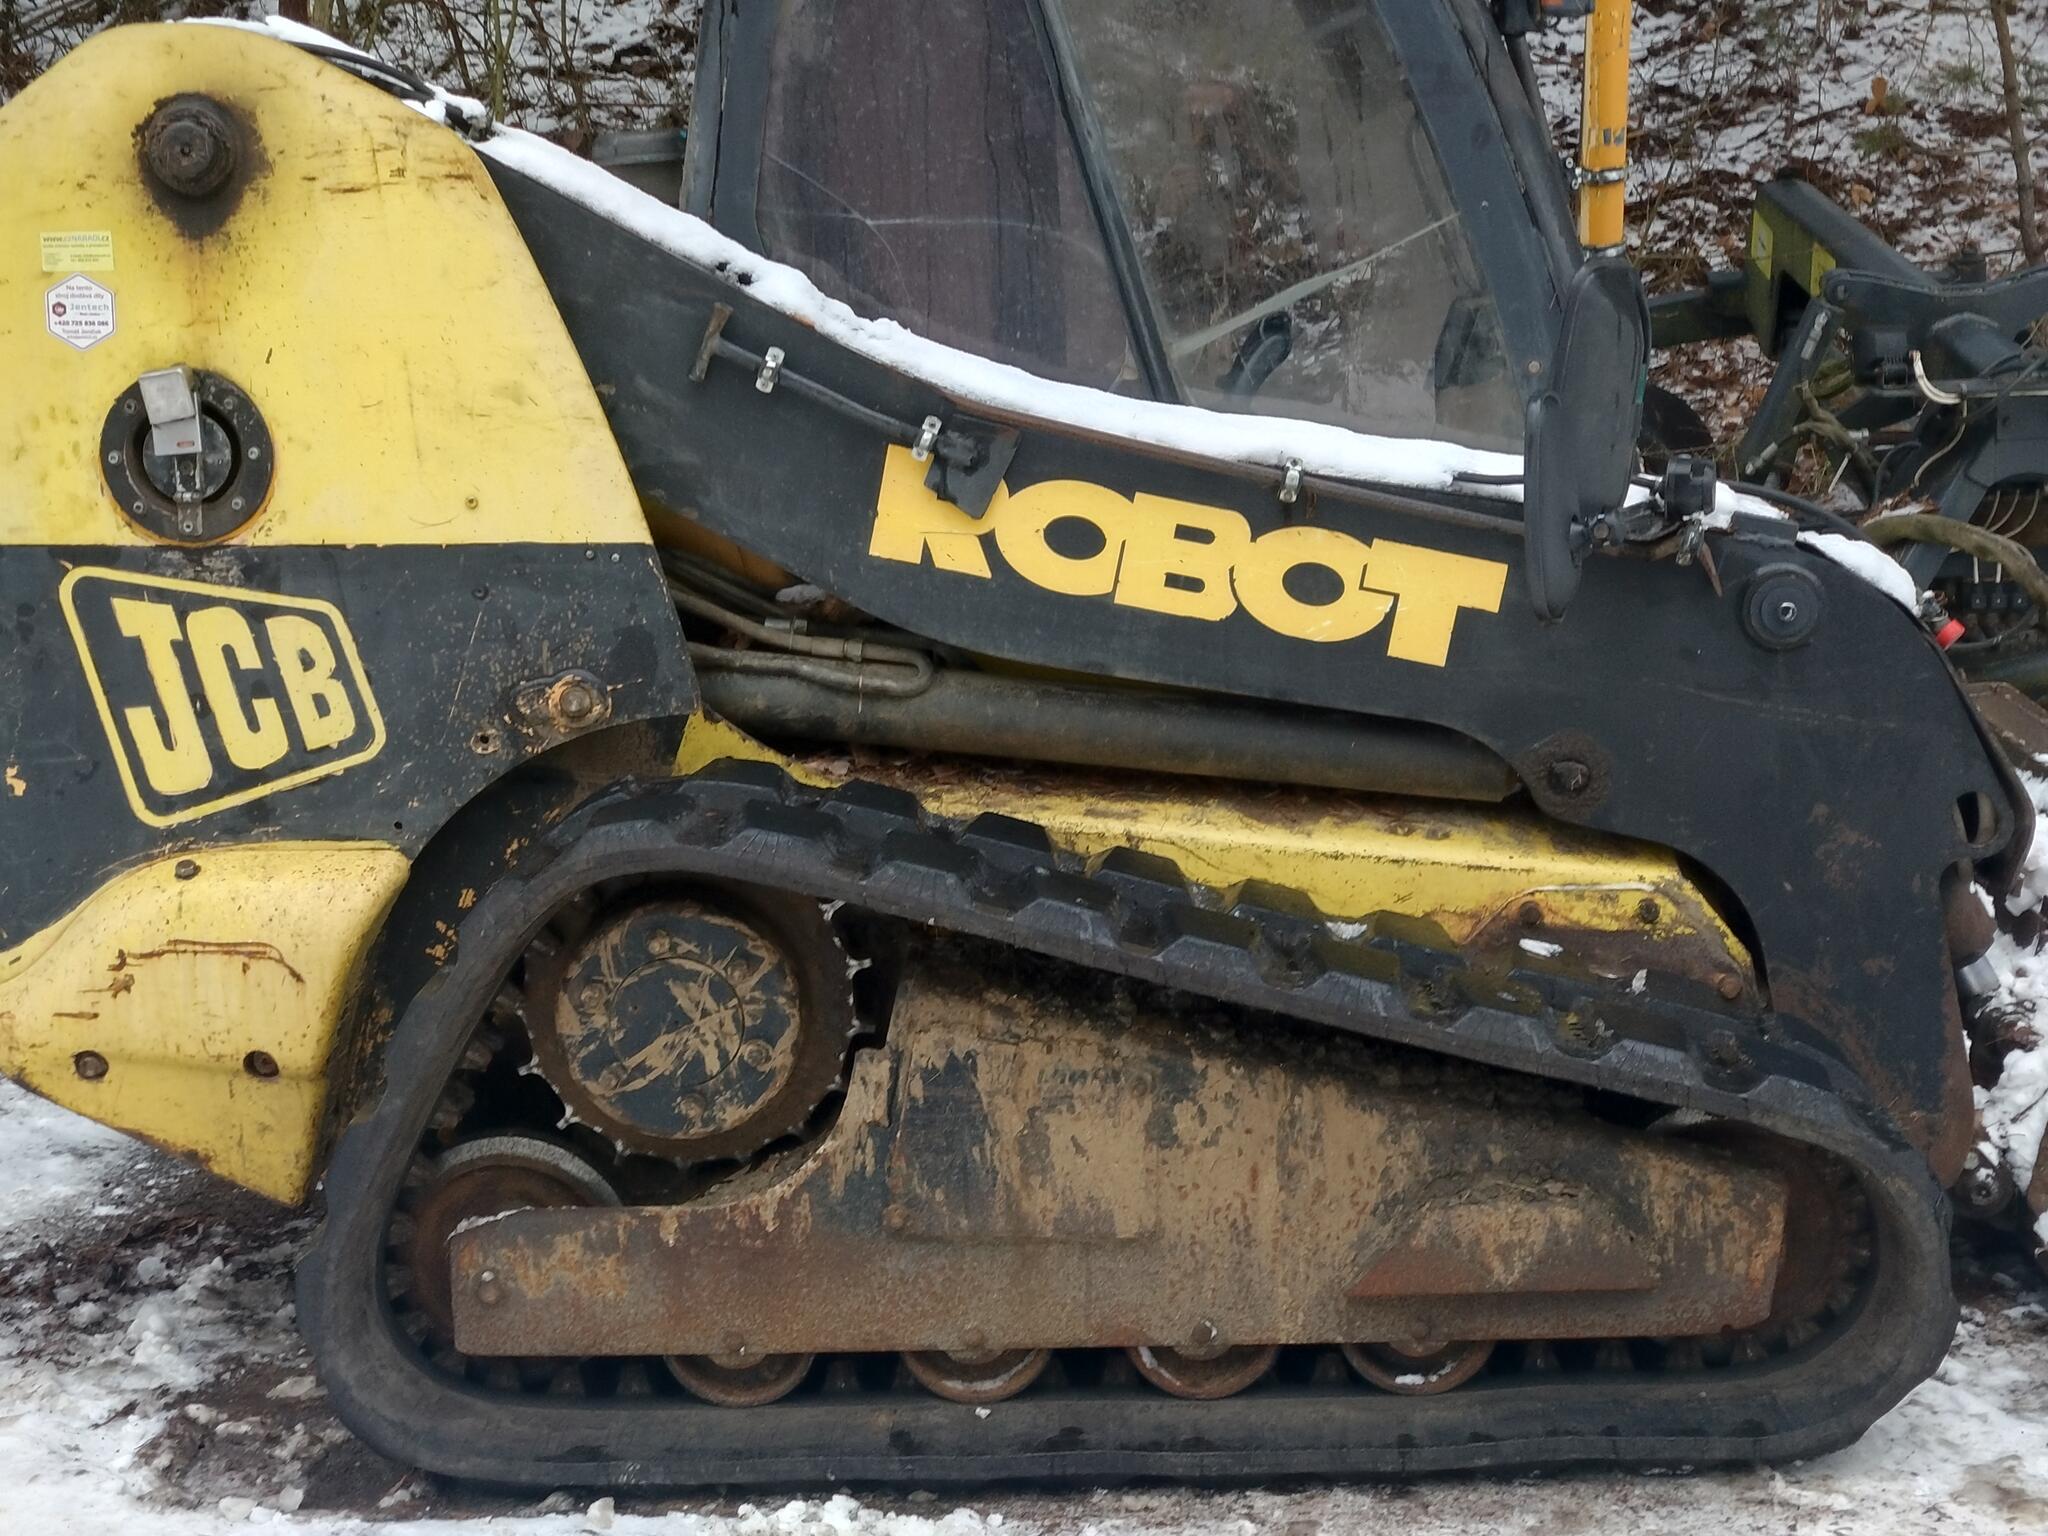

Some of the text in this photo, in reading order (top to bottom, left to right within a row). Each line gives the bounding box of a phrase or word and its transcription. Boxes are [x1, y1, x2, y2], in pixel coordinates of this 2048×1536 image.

[70, 303, 109, 311] Jentech
[868, 443, 1509, 667] ROBOT
[110, 597, 356, 795] JCB
